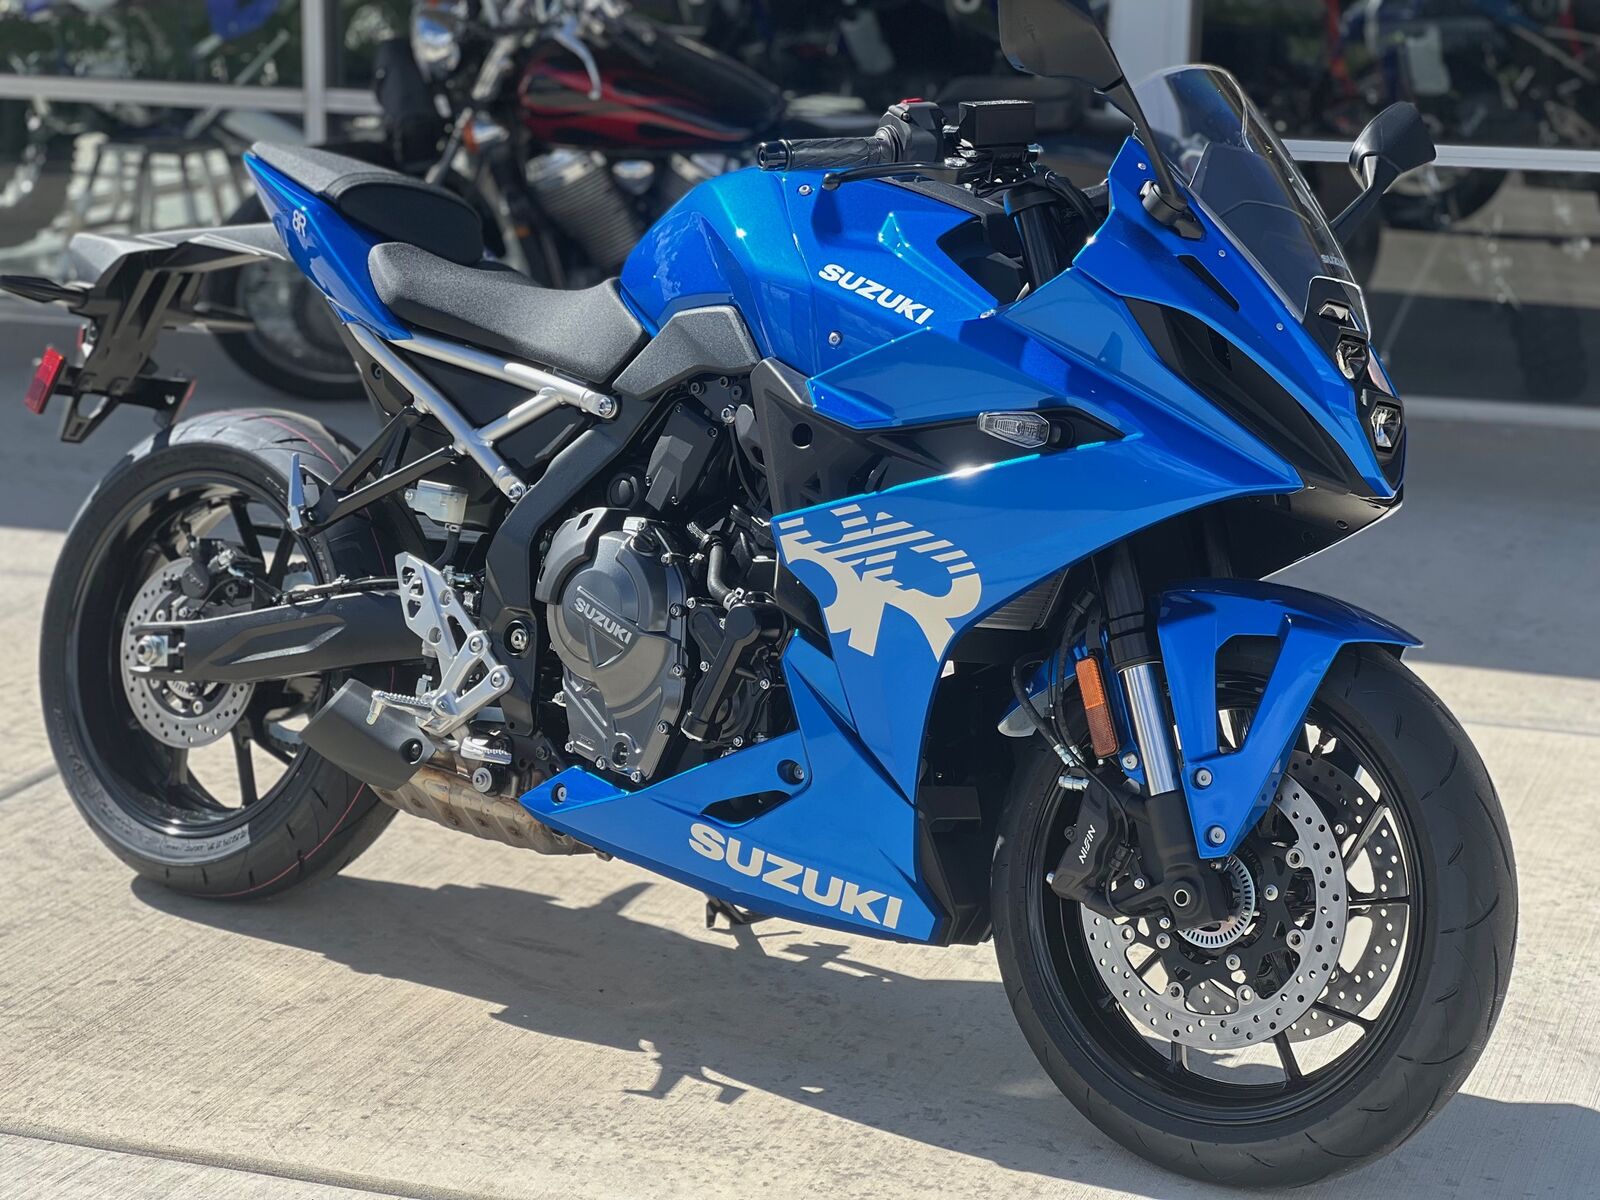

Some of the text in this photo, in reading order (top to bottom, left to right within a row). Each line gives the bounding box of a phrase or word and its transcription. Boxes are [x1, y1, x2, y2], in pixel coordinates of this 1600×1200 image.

[292, 210, 306, 237] 8R
[819, 264, 934, 325] SUZUKI
[574, 597, 632, 645] SUZUKI
[689, 823, 903, 929] SUZUKI
